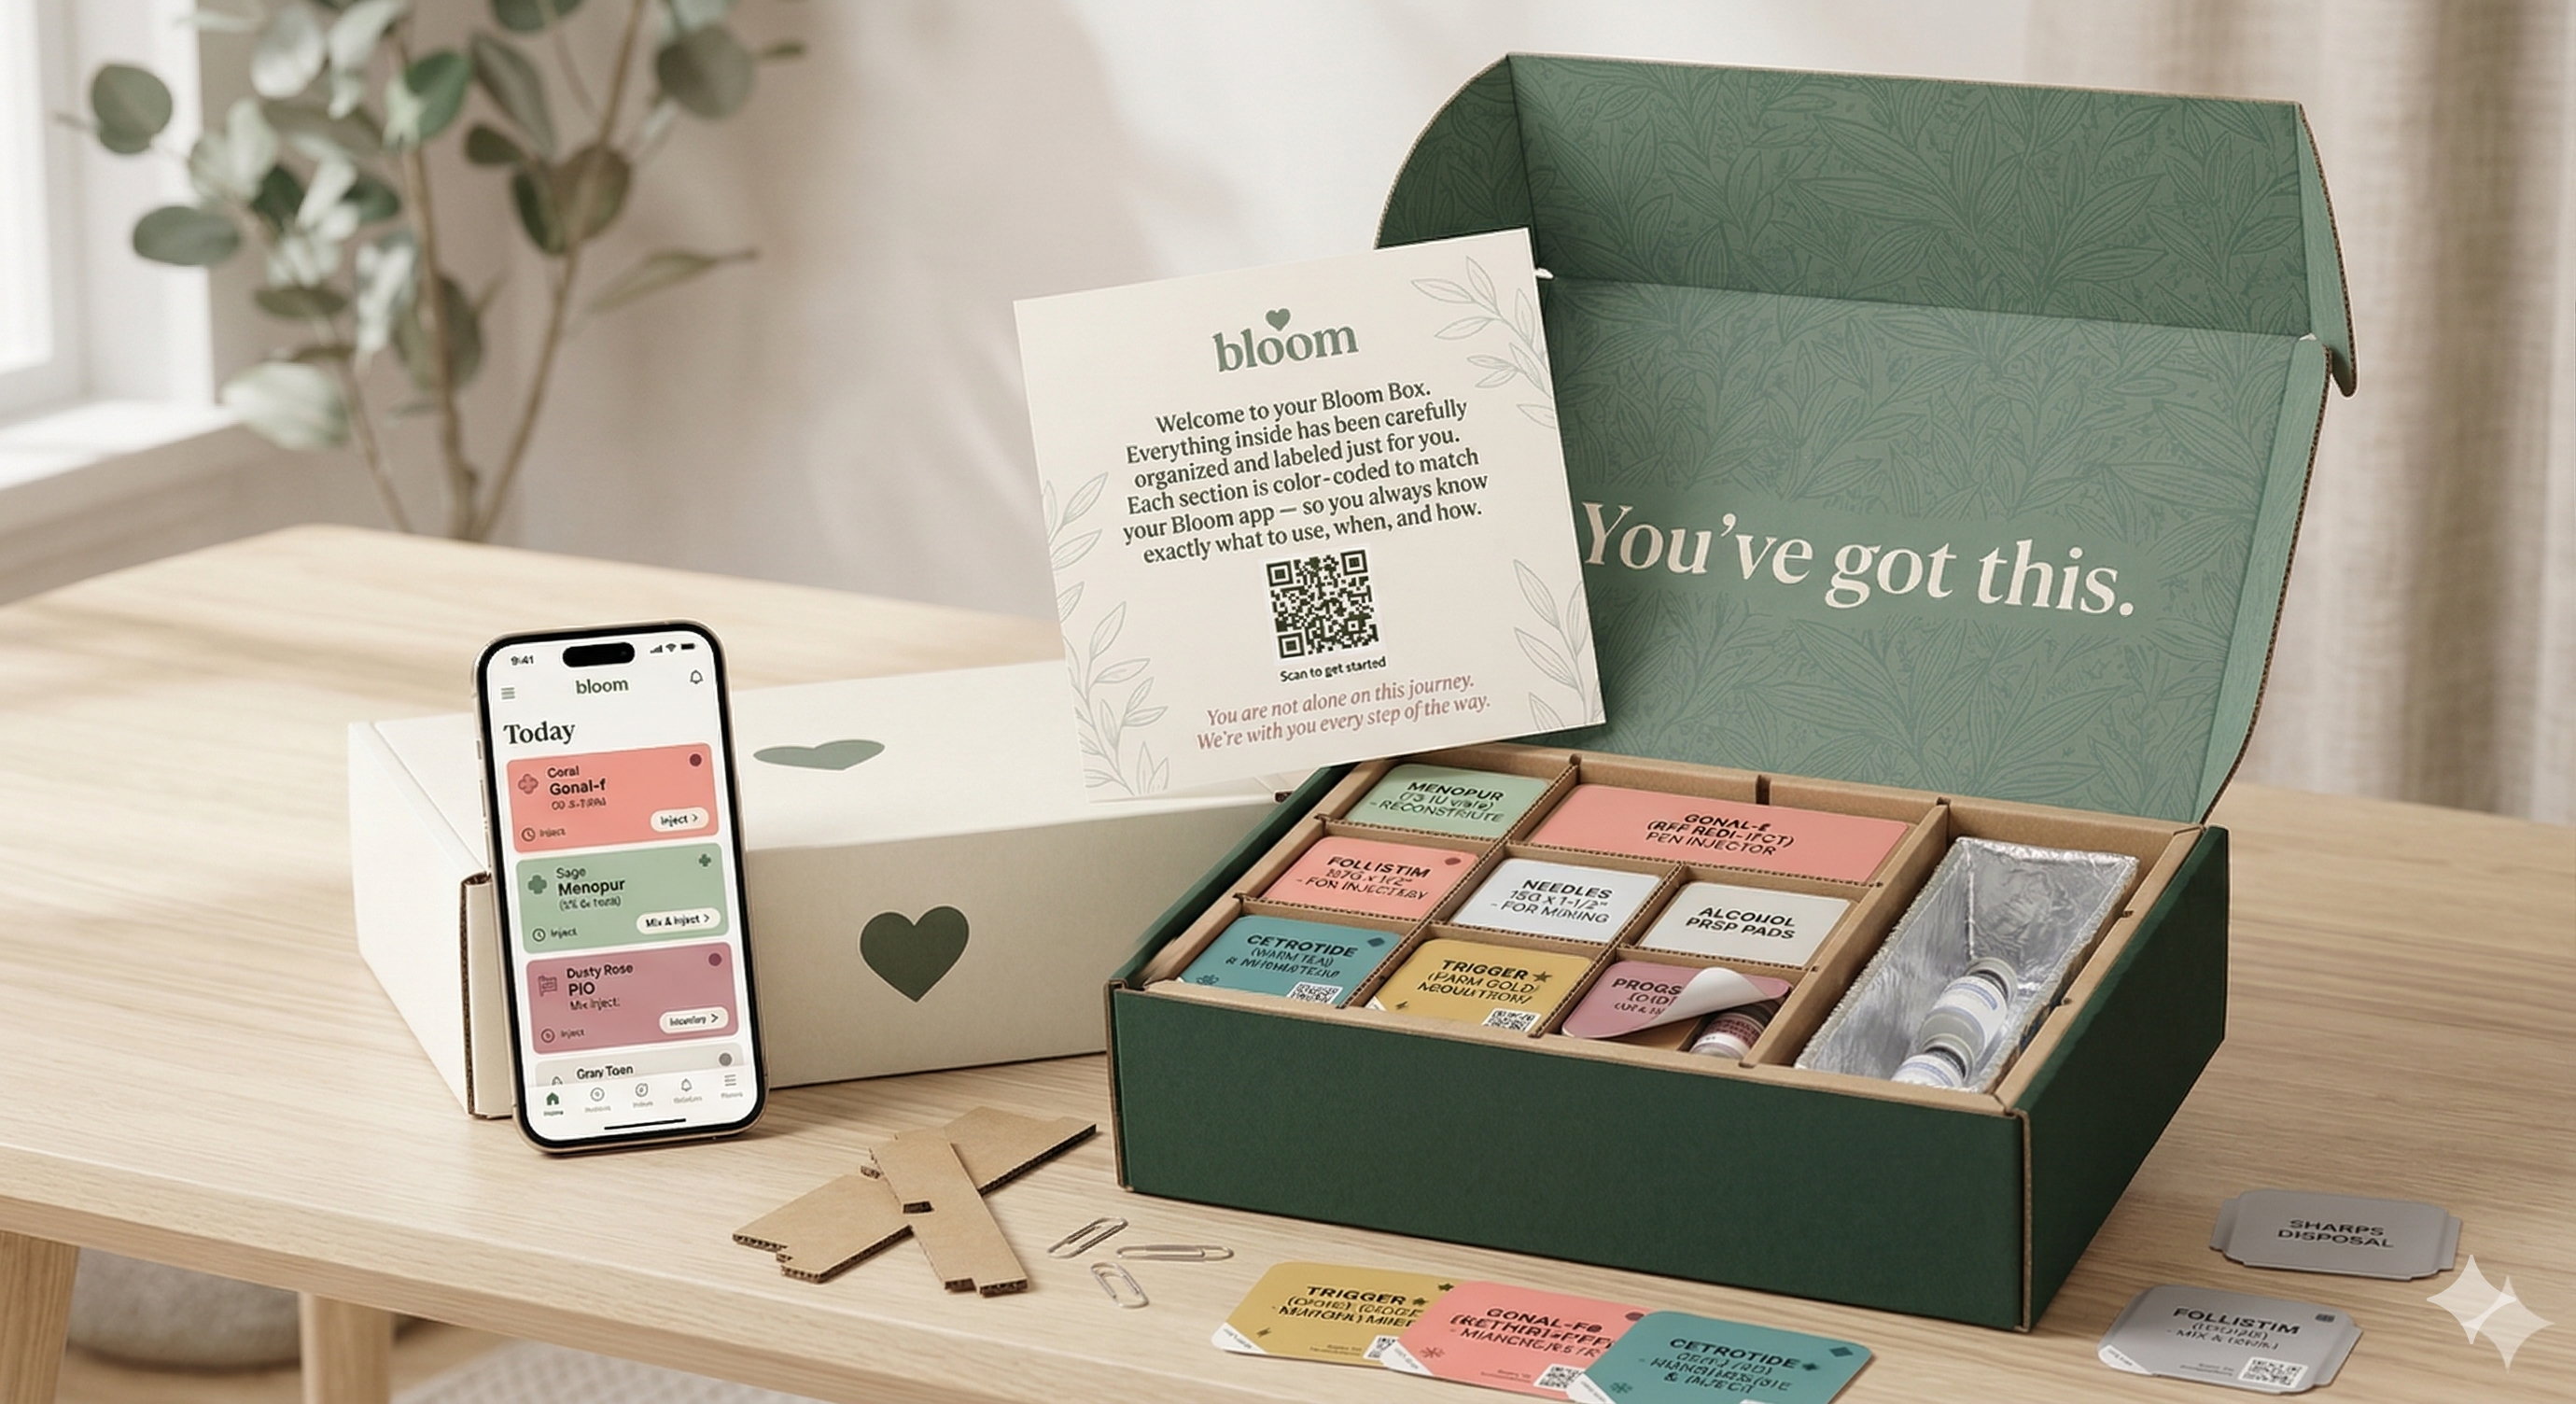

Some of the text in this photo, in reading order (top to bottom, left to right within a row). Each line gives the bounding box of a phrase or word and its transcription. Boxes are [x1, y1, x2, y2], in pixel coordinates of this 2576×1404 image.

[1212, 326, 1359, 372] bloom
[1155, 382, 1431, 433] Welcome to your Bloom Box.
[1126, 399, 1468, 464] Everything inside has been carefully
[1134, 429, 1461, 490] organized and labeled just for you.
[1127, 447, 1479, 514] Each section is color-coded to match
[1123, 522, 1168, 545] your
[1170, 512, 1234, 534] Bloom
[1239, 506, 1275, 527] app
[1302, 498, 1324, 515] so
[1328, 494, 1365, 515] you
[1368, 486, 1433, 504] always
[1435, 475, 1489, 497] know
[1143, 502, 1482, 564] exactly what to use, when, and how.
[1825, 542, 1957, 609] got
[1978, 539, 2135, 617] this.
[1281, 656, 1386, 682] Scan to get started
[576, 679, 629, 695] bloom
[1207, 674, 1475, 726] You are not alone on this journey.
[503, 721, 576, 745] Today
[1197, 695, 1491, 750] We're with you every step of the way.
[547, 765, 581, 779] Coral
[550, 779, 607, 795] Gonal-f
[1407, 782, 1505, 802] MENOPUR
[1645, 832, 1777, 856] PEN INJECTOR
[1327, 856, 1431, 878] FOLLISTIM
[558, 880, 625, 896] Menopur
[1522, 879, 1614, 899] NEEDLES
[1501, 901, 1539, 914] FOR
[1686, 917, 1795, 939] PRSP PADS
[1247, 934, 1359, 959] CETROTIDE
[567, 963, 634, 980] Dusty Rose
[1442, 960, 1529, 980] TRIGGER
[568, 981, 595, 996] PIO
[2277, 1229, 2394, 1248] DISPOSAL
[2289, 1219, 2385, 1236] SHARPS
[1307, 1285, 1407, 1305] TRIGGER
[2173, 1308, 2301, 1335] FOLLISTIM
[2177, 1329, 2206, 1340] MIX
[1670, 1339, 1801, 1369] CETROTIDE
